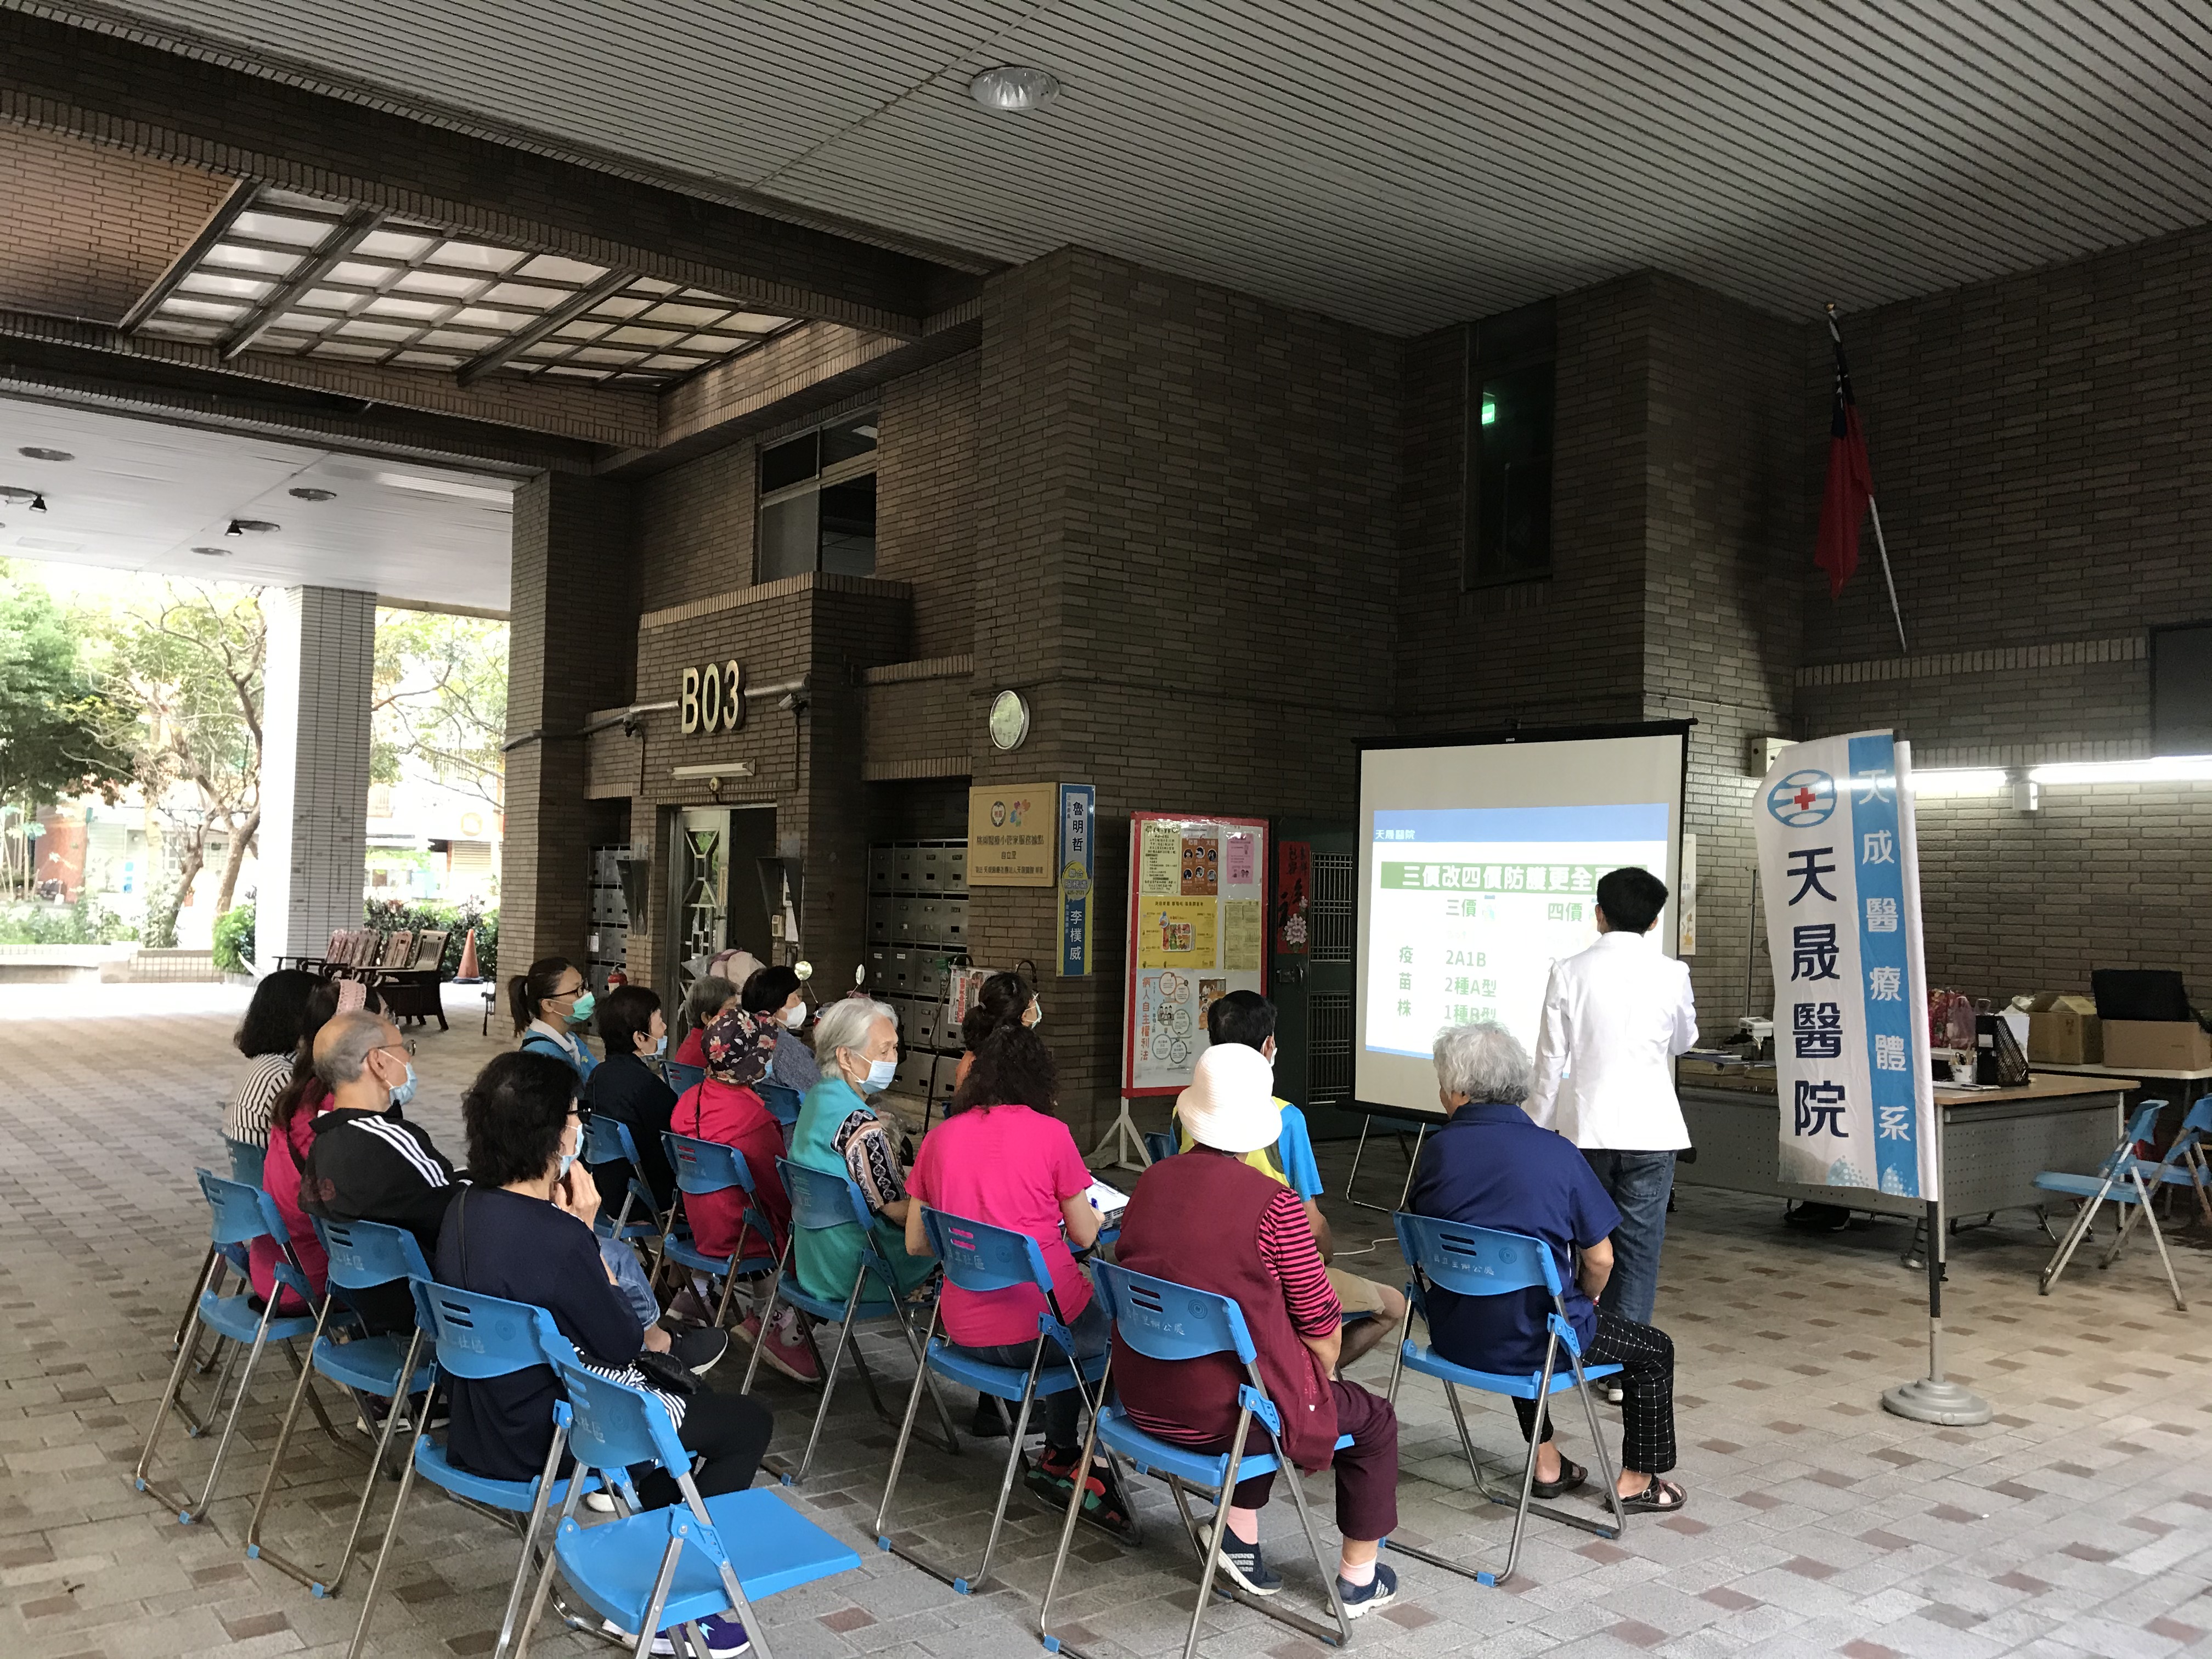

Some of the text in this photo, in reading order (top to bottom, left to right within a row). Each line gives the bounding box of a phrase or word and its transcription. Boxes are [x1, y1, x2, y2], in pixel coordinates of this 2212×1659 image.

[681, 659, 740, 734] B03
[1072, 801, 1084, 852] 魯明哲
[1001, 850, 1017, 859] 自立里
[1445, 898, 1477, 918] 三價
[1547, 902, 1583, 922] 四價
[1445, 950, 1487, 967] 2A1B
[1857, 768, 1911, 1143] 天成醫療體系
[1444, 976, 1497, 998] 2種A型
[1786, 845, 1849, 1139] 天晟醫院
[1140, 977, 1151, 1061] 病人自主權利法
